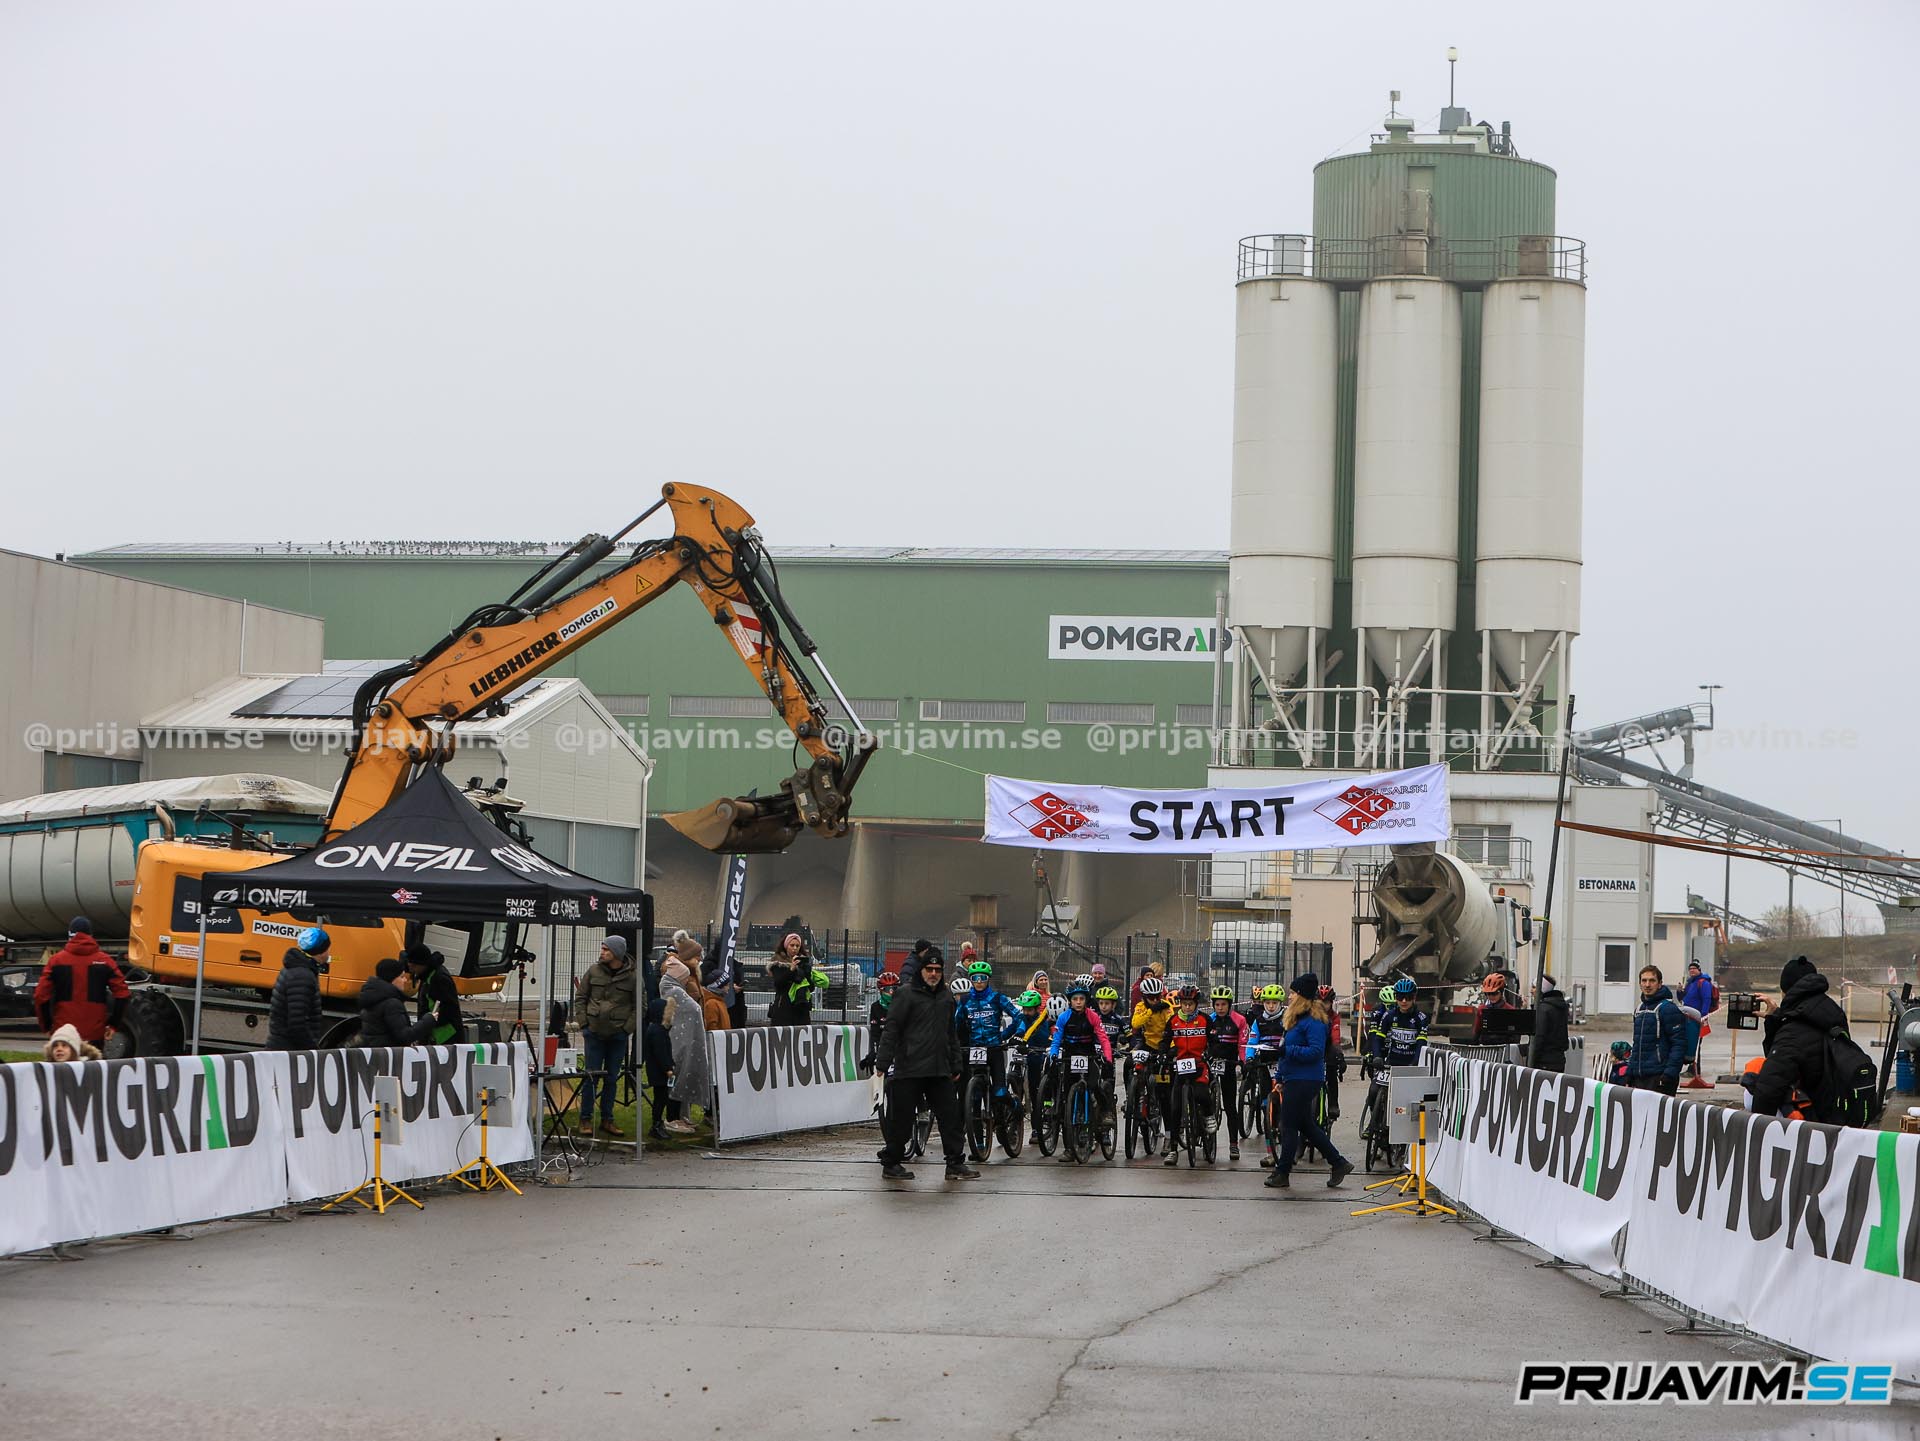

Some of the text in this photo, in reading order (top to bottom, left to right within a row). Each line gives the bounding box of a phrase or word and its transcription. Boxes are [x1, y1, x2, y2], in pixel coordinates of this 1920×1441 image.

[561, 600, 615, 639] POMGRAD
[1059, 625, 1233, 652] POMGRAD
[469, 631, 562, 698] LIEBHERR
[1369, 798, 1411, 812] KLUB
[1061, 813, 1100, 828] TEAM
[1129, 797, 1295, 841] START
[1347, 816, 1416, 830] TROPOVCI
[1579, 879, 1636, 890] BETONARNA
[506, 898, 537, 908] ENJOY
[972, 1050, 984, 1060] 41
[1134, 1053, 1146, 1062] 46
[1073, 1058, 1085, 1069] 40
[1180, 1060, 1193, 1071] 39
[1211, 1060, 1223, 1070] 45
[1470, 1062, 1634, 1201] POMGRAD
[1648, 1096, 1920, 1284] POMGRA
